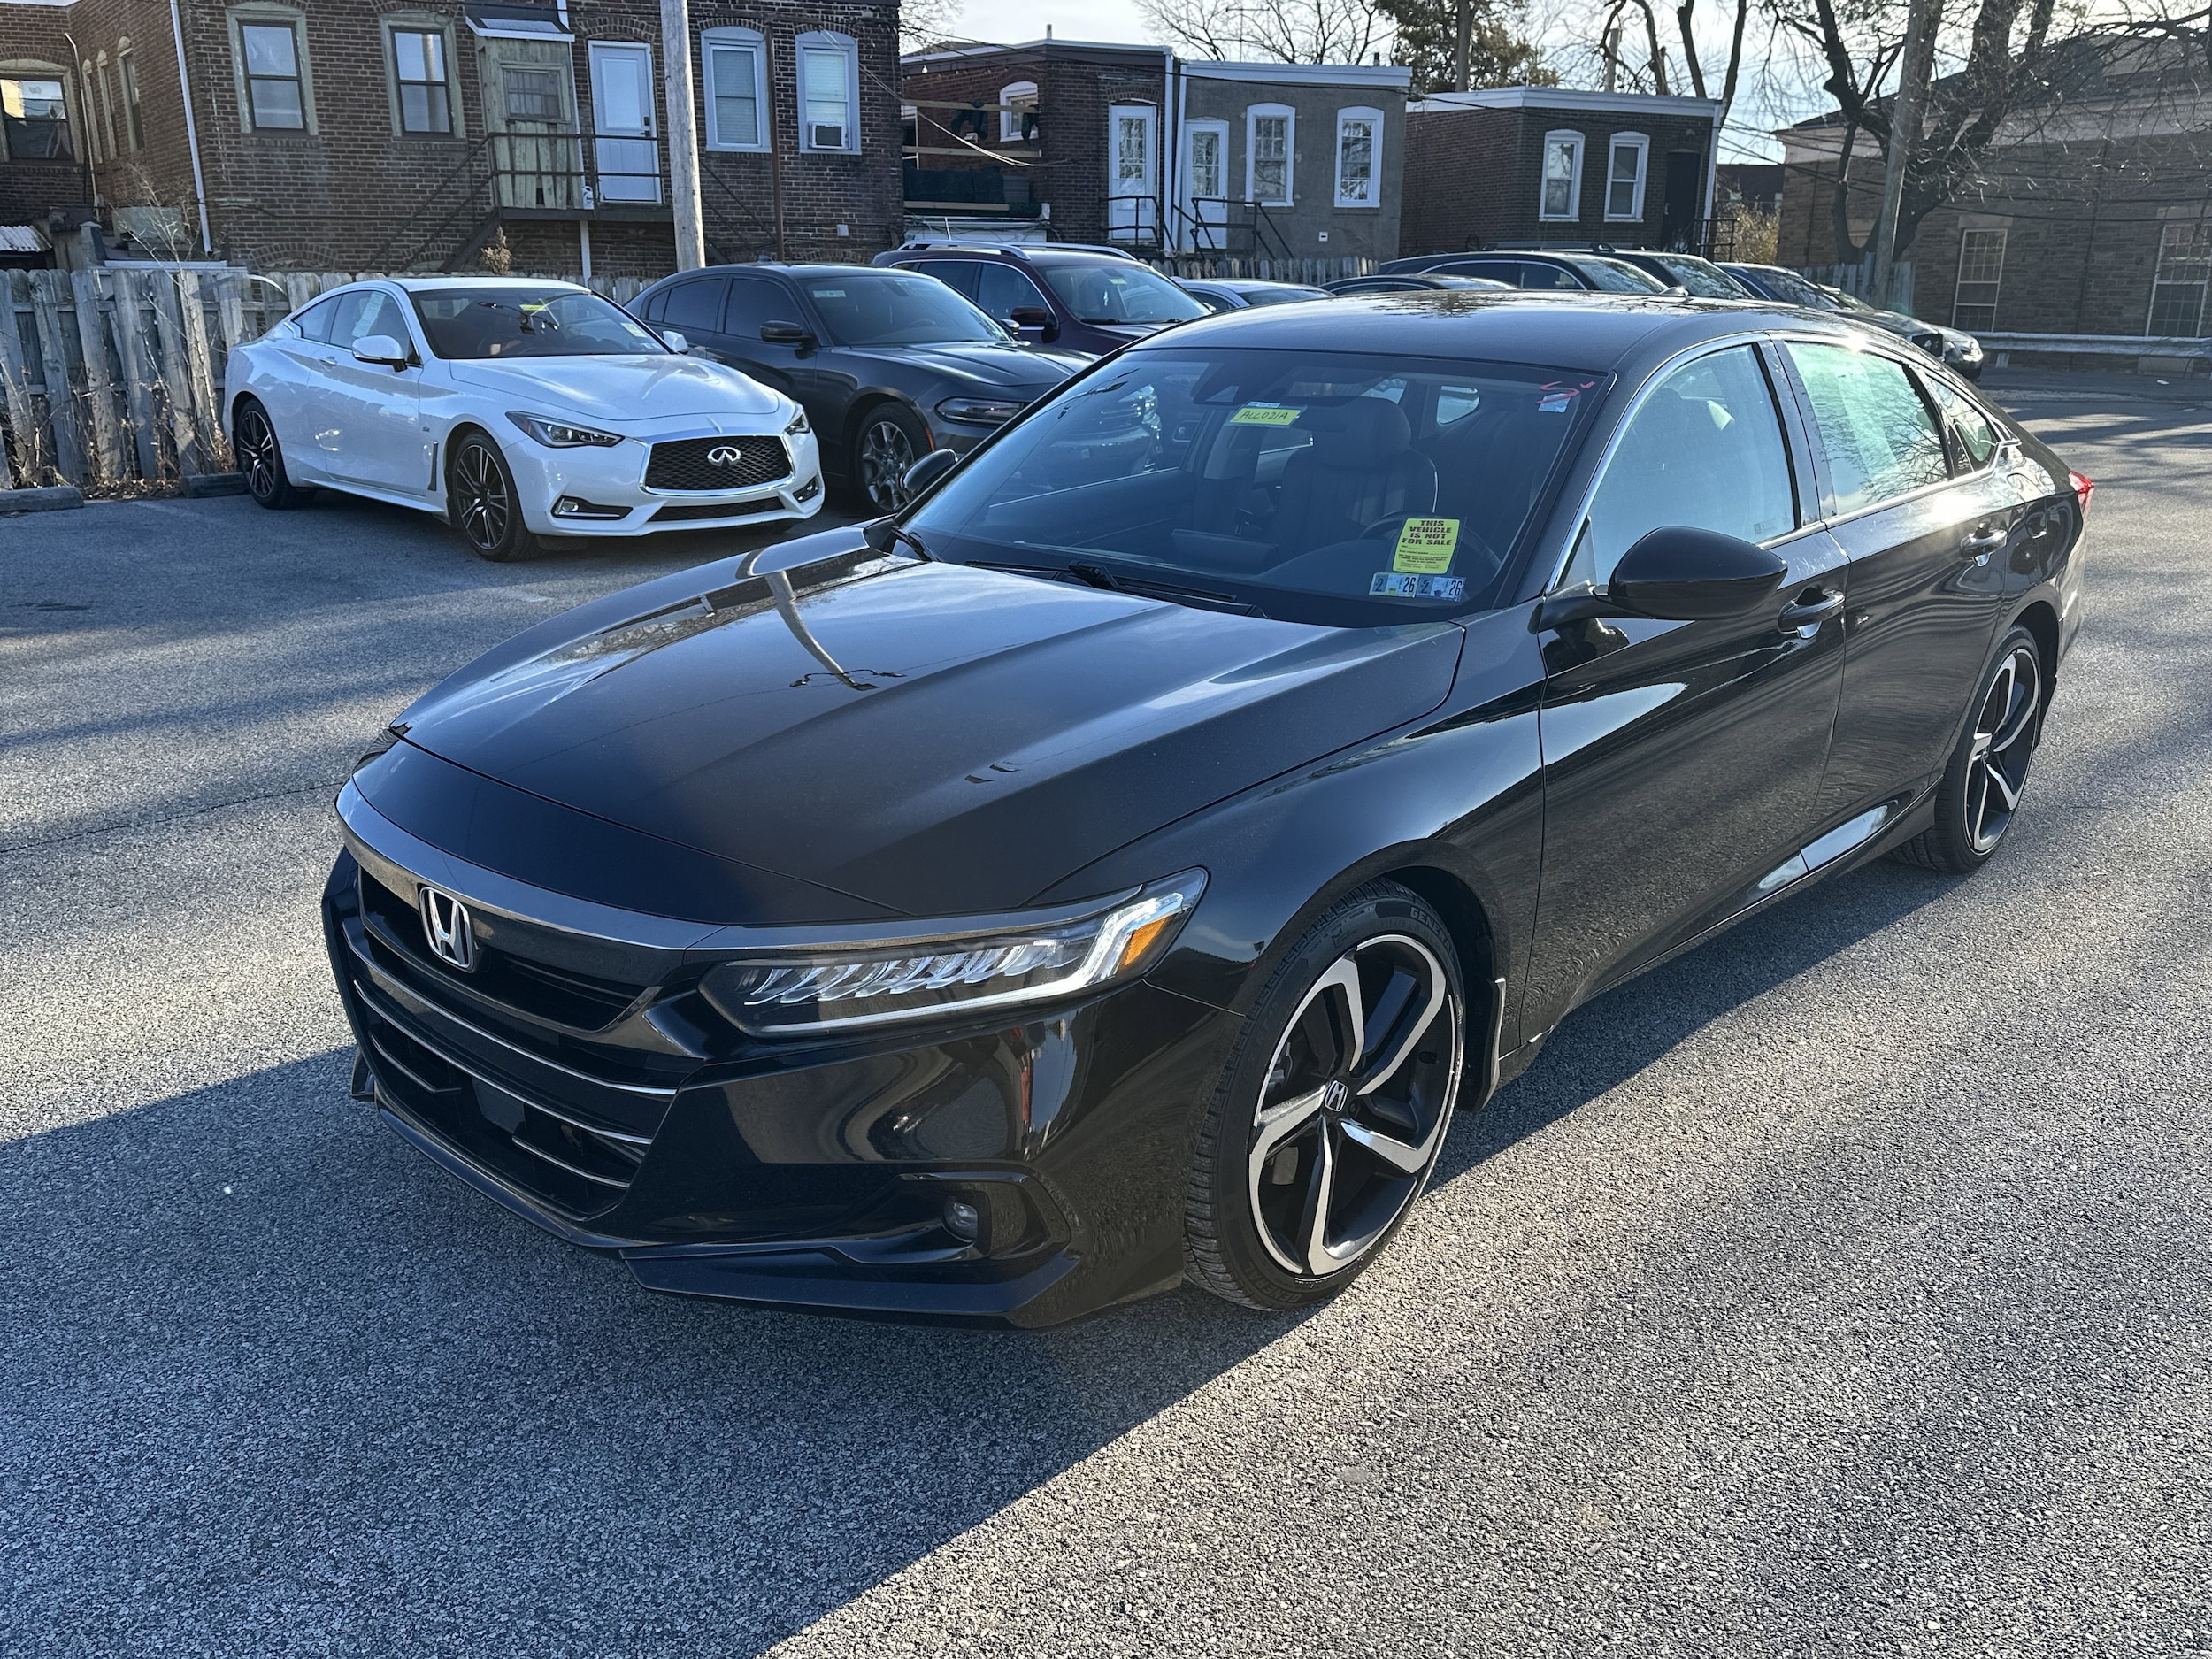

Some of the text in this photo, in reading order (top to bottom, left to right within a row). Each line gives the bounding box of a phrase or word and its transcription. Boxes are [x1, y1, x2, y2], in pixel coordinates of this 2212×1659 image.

[1374, 578, 1384, 592] 2
[1402, 577, 1417, 593] 26
[1420, 579, 1430, 594] 2
[1448, 580, 1463, 596] 26
